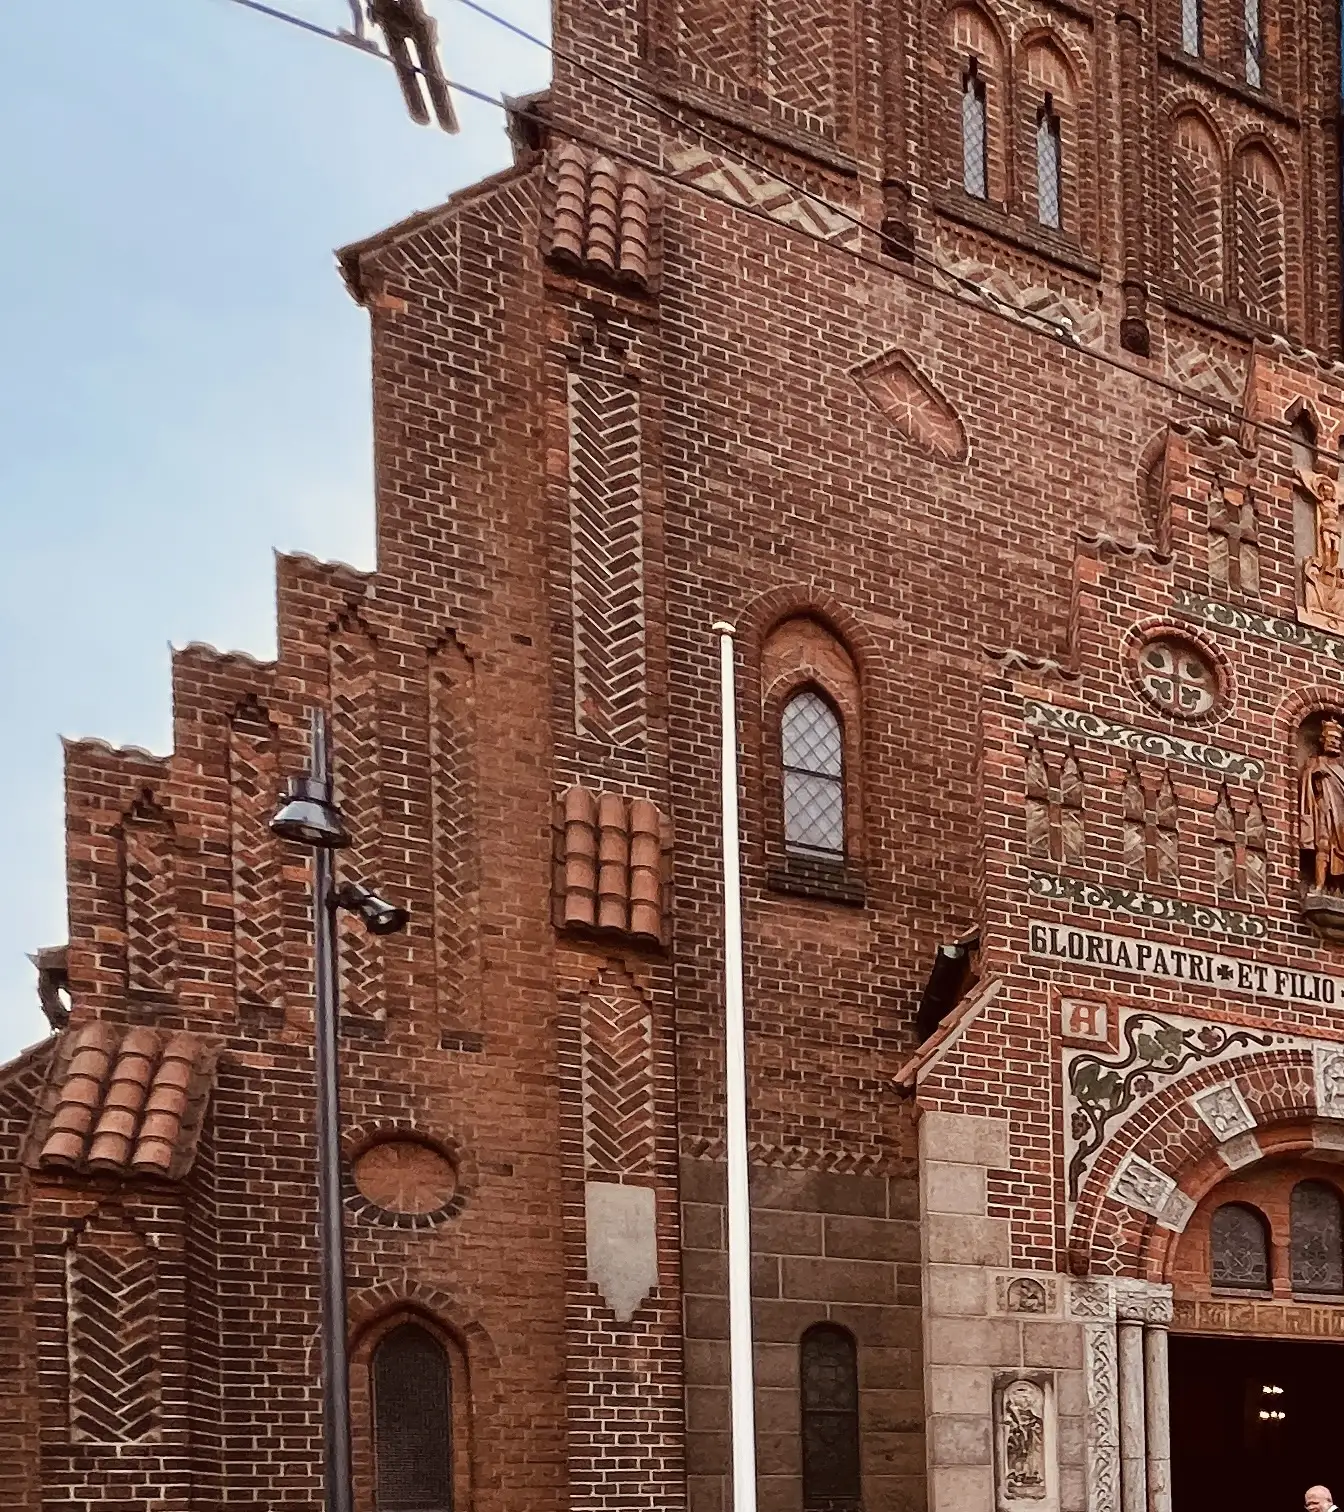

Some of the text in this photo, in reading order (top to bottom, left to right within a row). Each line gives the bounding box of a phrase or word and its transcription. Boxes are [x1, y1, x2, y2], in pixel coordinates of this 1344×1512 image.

[1030, 924, 1132, 969] GLORIA
[1135, 943, 1215, 984] PATRI
[1236, 960, 1269, 993] ET
[1273, 968, 1335, 1004] FILIO
